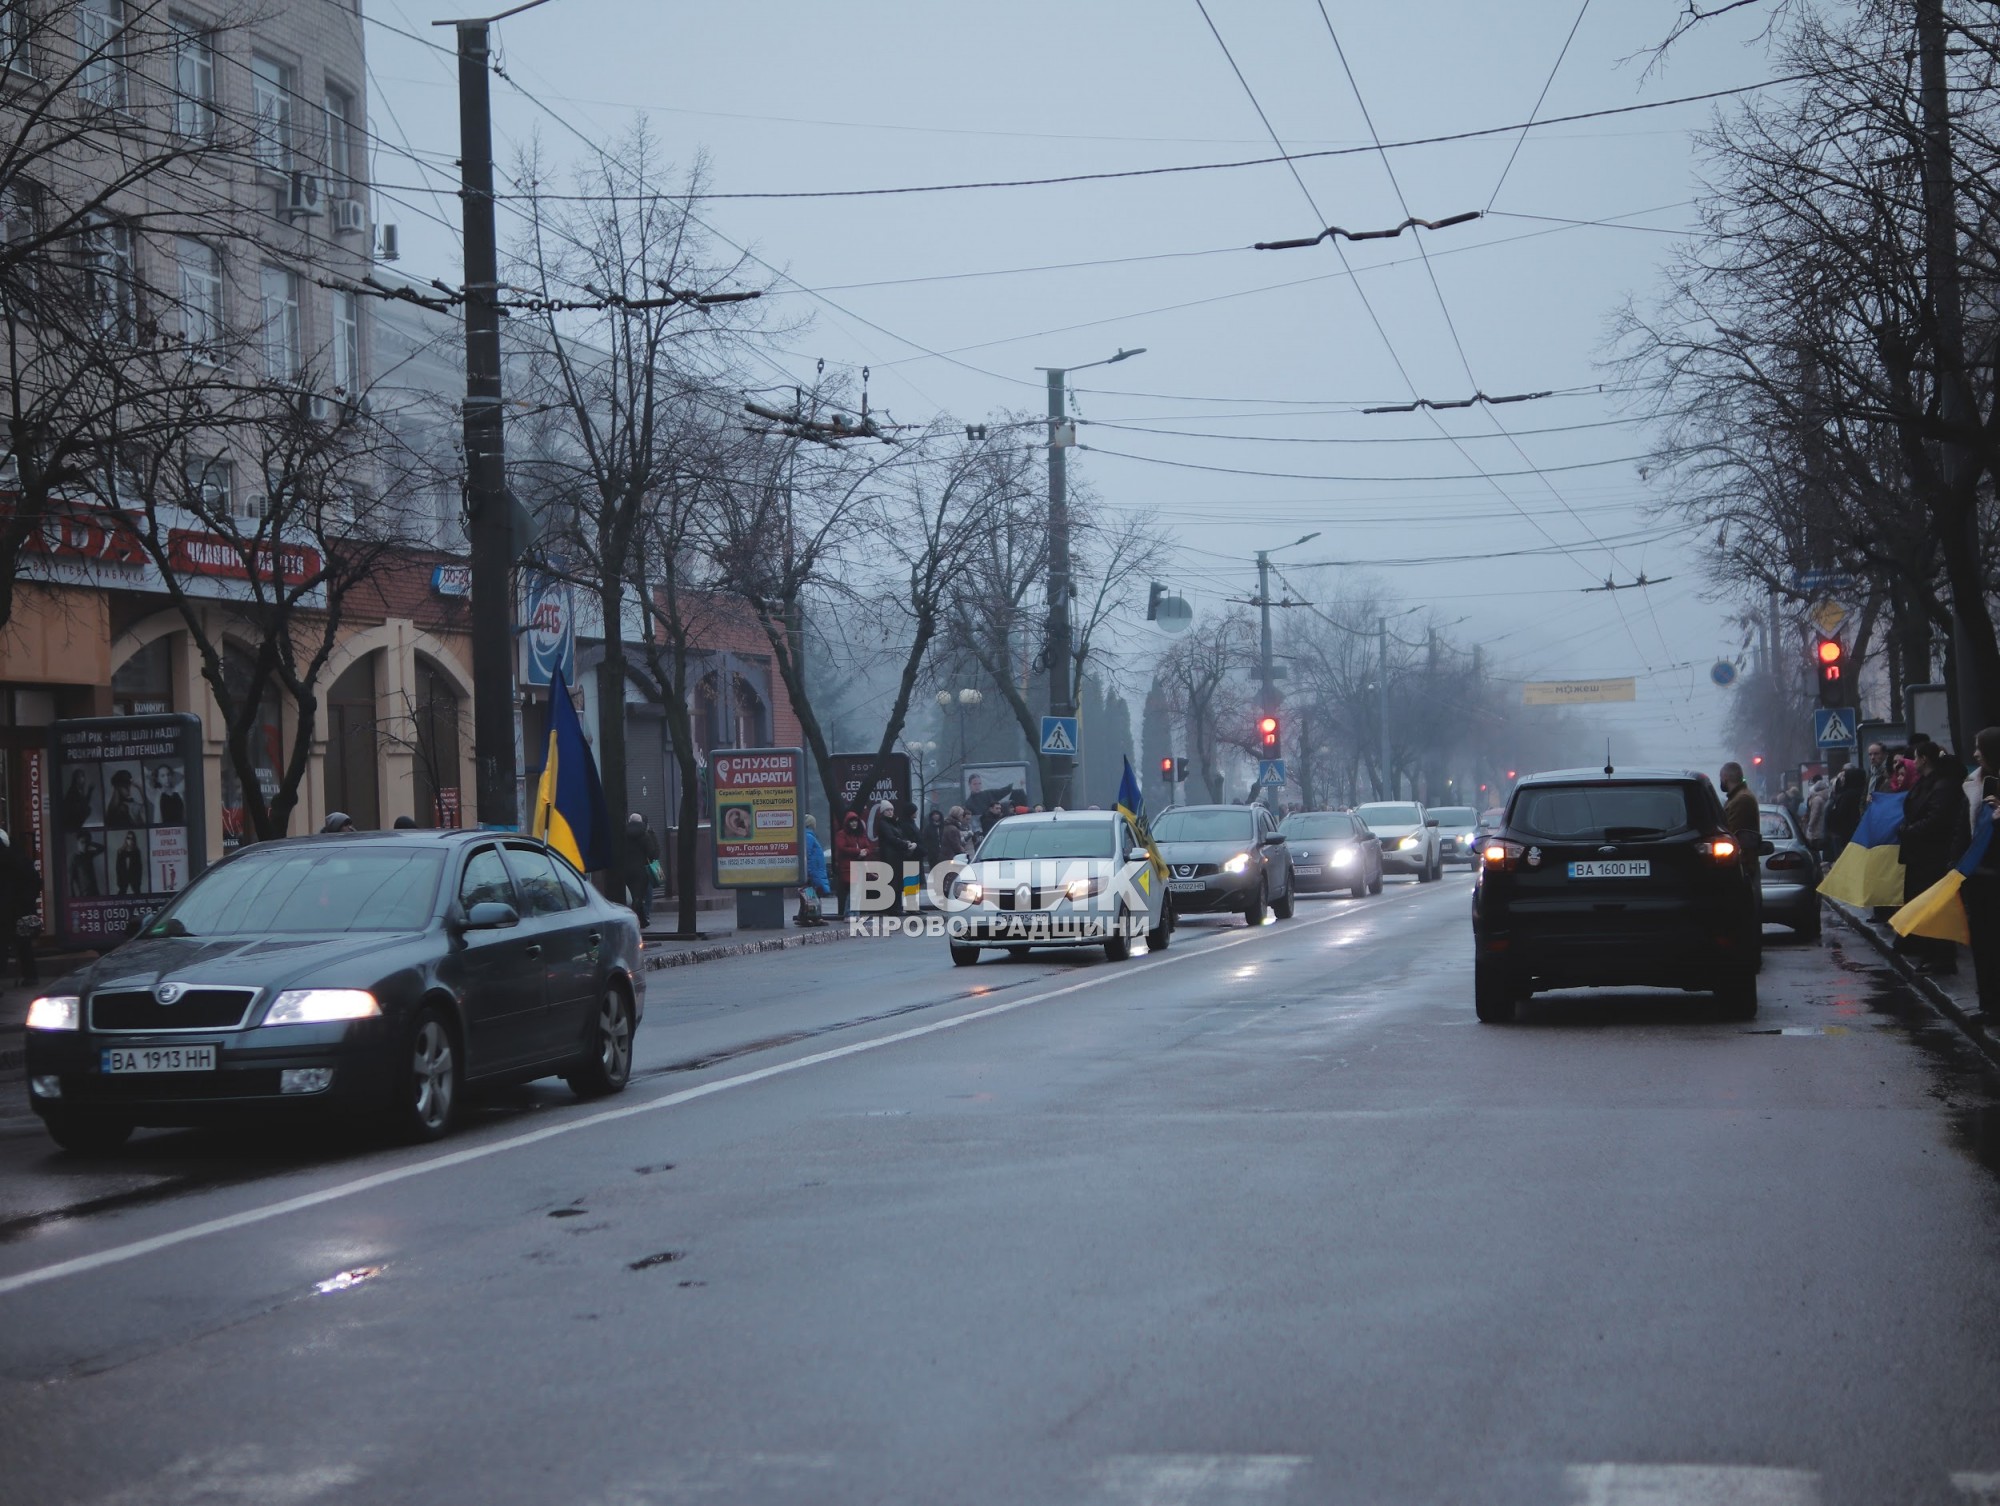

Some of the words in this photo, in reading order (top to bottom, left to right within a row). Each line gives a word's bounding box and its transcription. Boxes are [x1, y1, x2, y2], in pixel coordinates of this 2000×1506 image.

[187, 542, 250, 568] ЧОЛОВІЧ
[533, 602, 561, 634] АТБ
[134, 703, 165, 713] КОМФОРТ
[88, 732, 103, 743] РІК
[110, 730, 129, 742] НОВІ
[104, 744, 124, 758] СВІЙ
[733, 757, 792, 769] СЛУХОВІ
[733, 771, 792, 784] АПАРАТИ
[845, 777, 892, 791] СЕЗНИЙ
[841, 790, 898, 801] РОЗОДАЖ
[726, 845, 742, 853] вул.
[743, 844, 768, 852] Гоголя
[1576, 864, 1594, 876] BA
[1598, 863, 1626, 875] 1600
[1629, 862, 1647, 874] HH
[80, 909, 99, 920] +38
[103, 908, 129, 921] (050)
[133, 906, 164, 917] 458-
[80, 921, 100, 932] +38
[104, 920, 129, 934] (050
[112, 1053, 136, 1070] BA
[143, 1051, 180, 1069] 1913
[186, 1050, 210, 1068] HH
